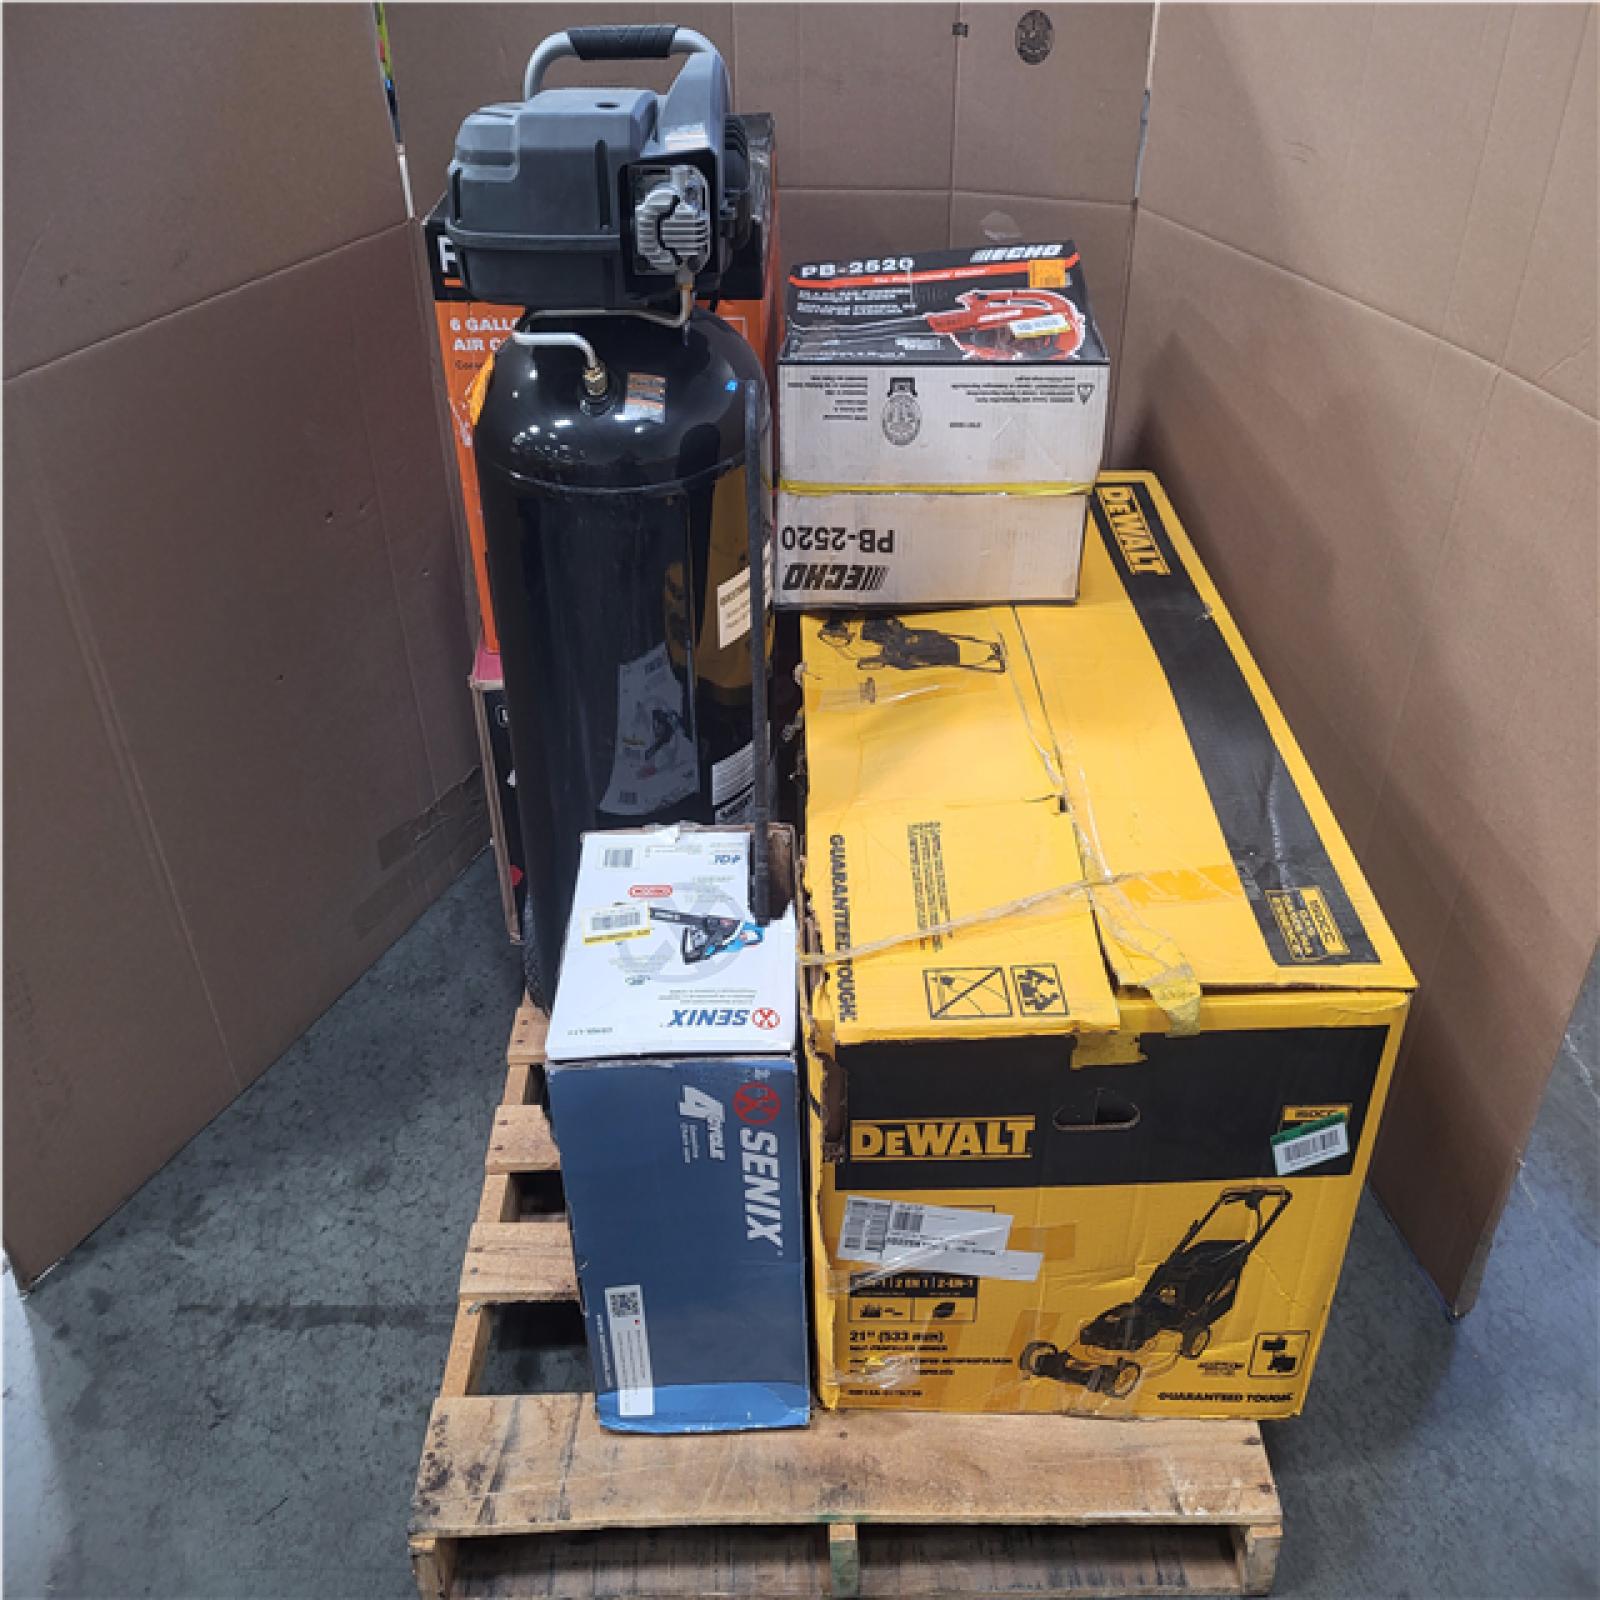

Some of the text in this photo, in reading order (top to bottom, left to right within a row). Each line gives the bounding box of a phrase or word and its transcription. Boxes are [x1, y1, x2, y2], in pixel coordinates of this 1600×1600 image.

[782, 526, 895, 553] PB-2520
[782, 564, 872, 590] ECHO
[669, 1008, 751, 1026] SENIX
[738, 1126, 783, 1248] SENIX
